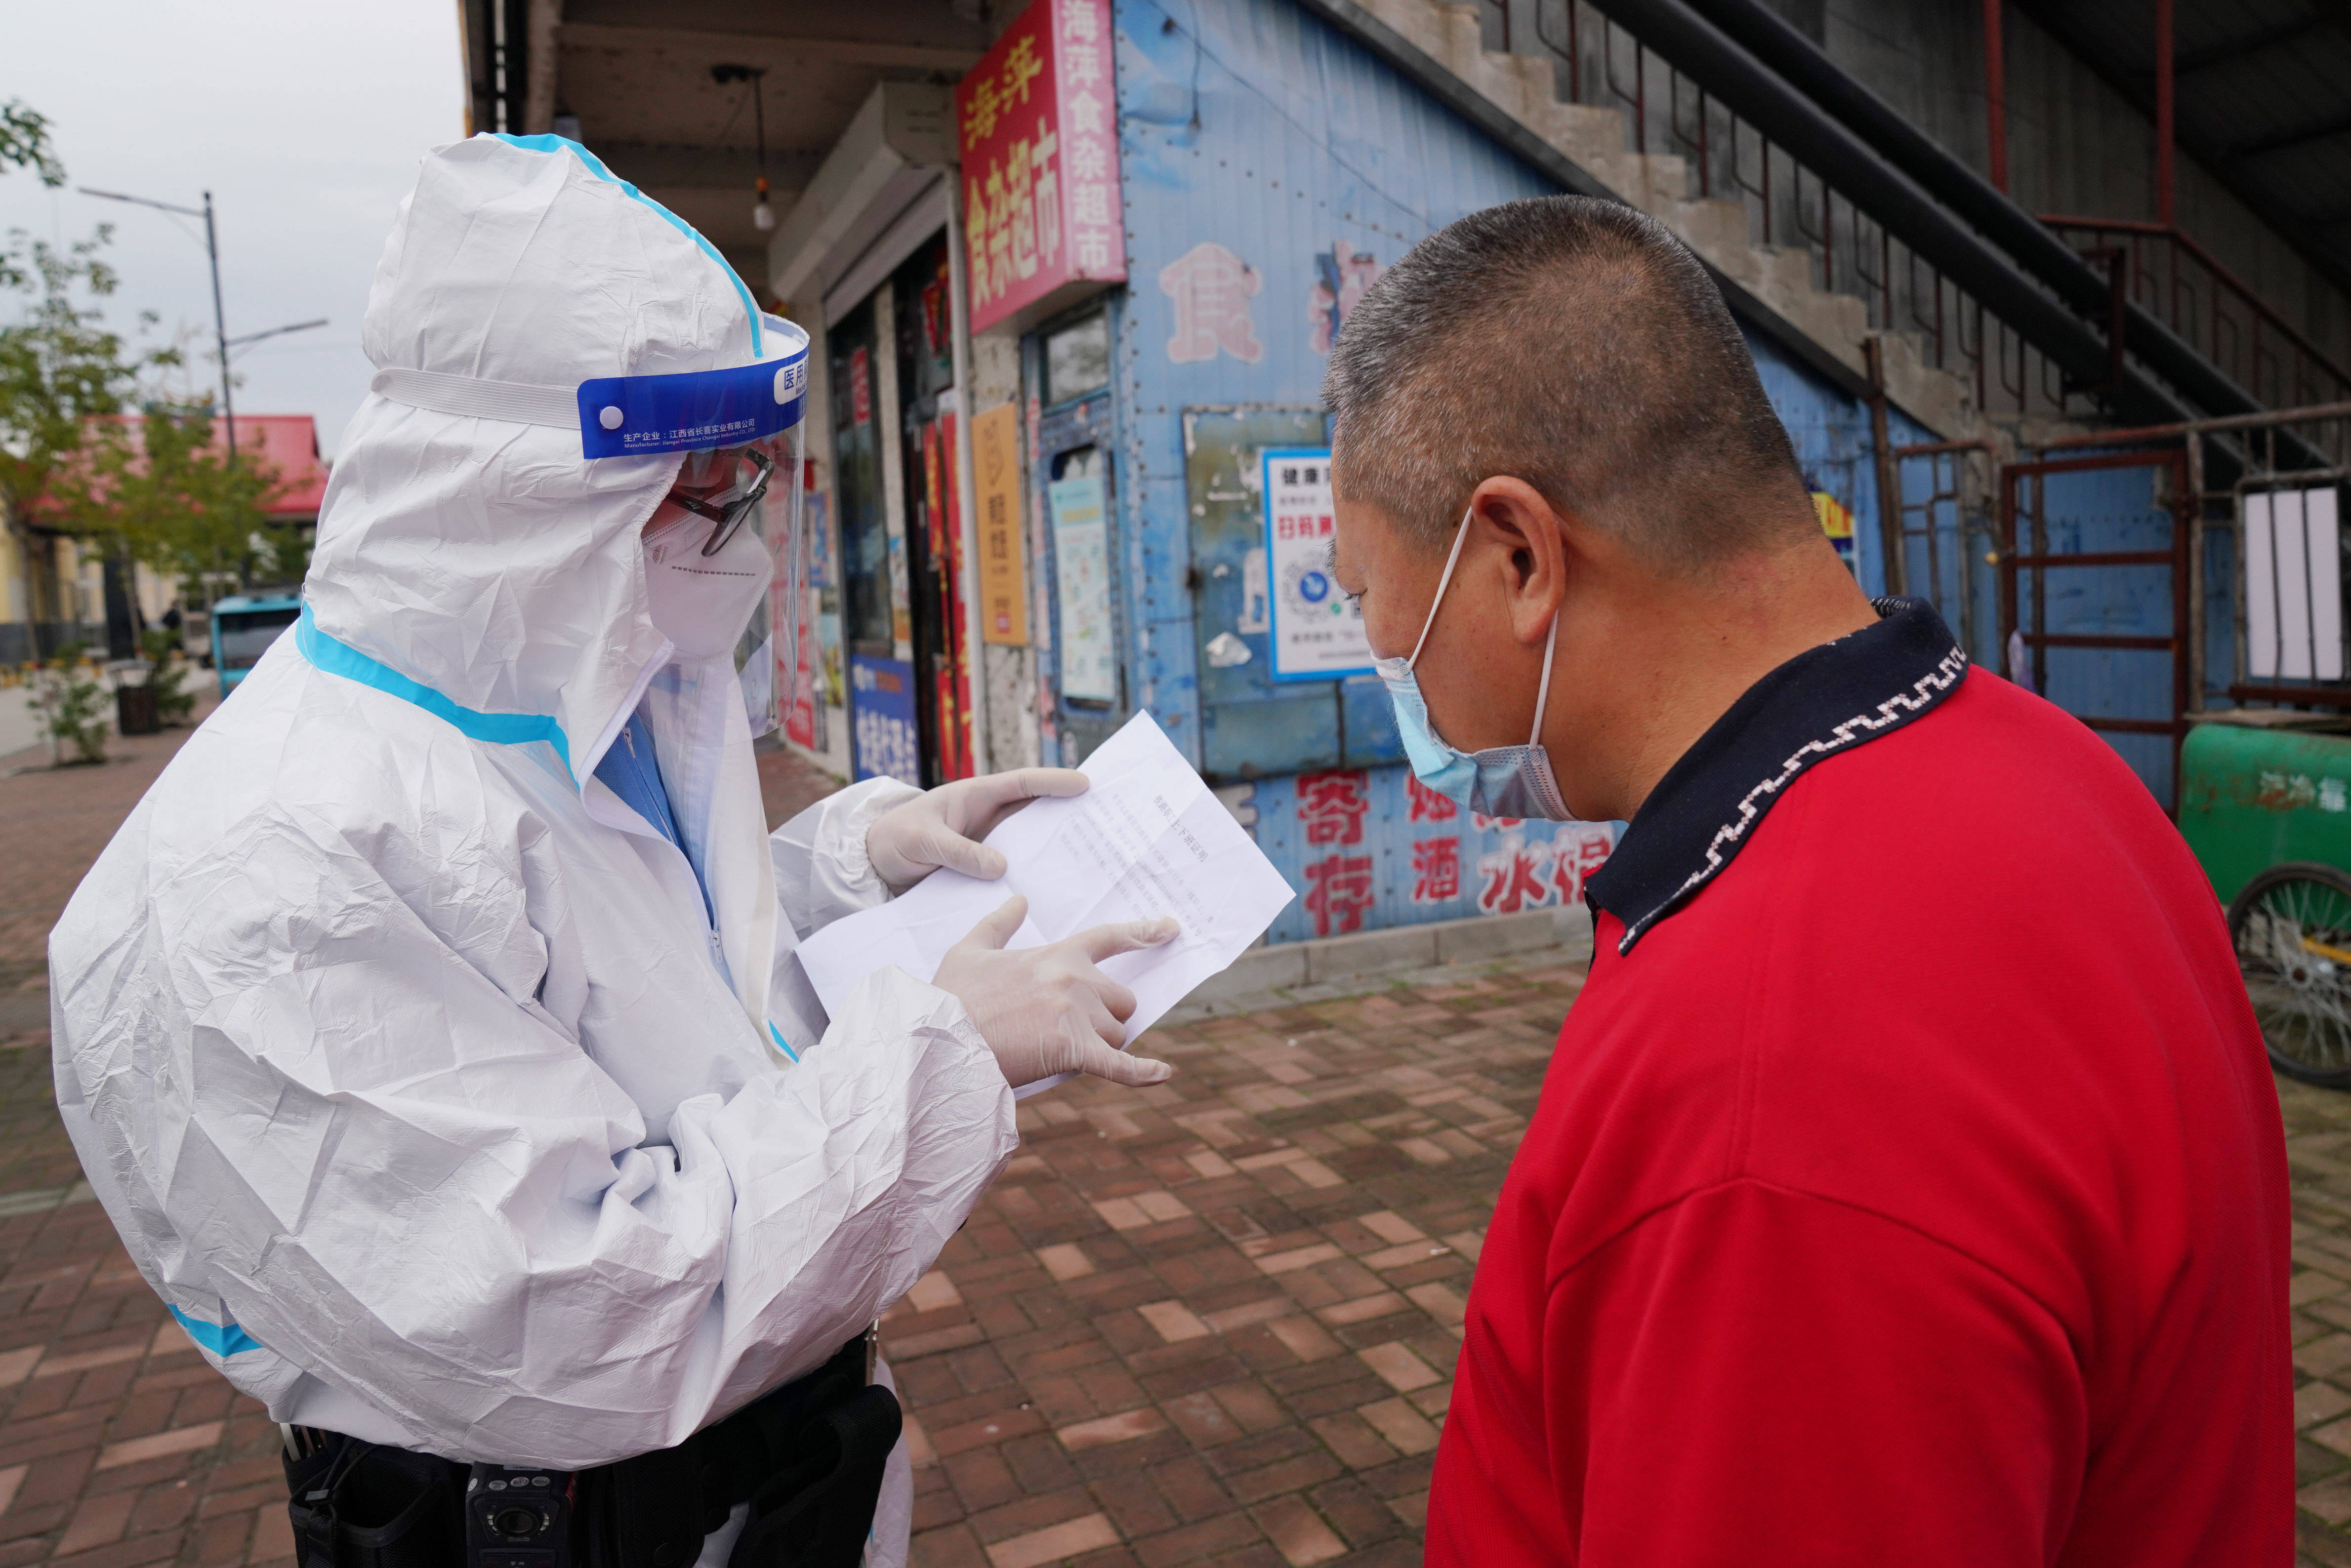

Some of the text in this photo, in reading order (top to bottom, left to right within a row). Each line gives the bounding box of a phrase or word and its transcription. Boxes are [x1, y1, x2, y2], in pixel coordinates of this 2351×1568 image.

[966, 115, 1060, 314] 食杂超市
[1296, 769, 1374, 936] 寄存
